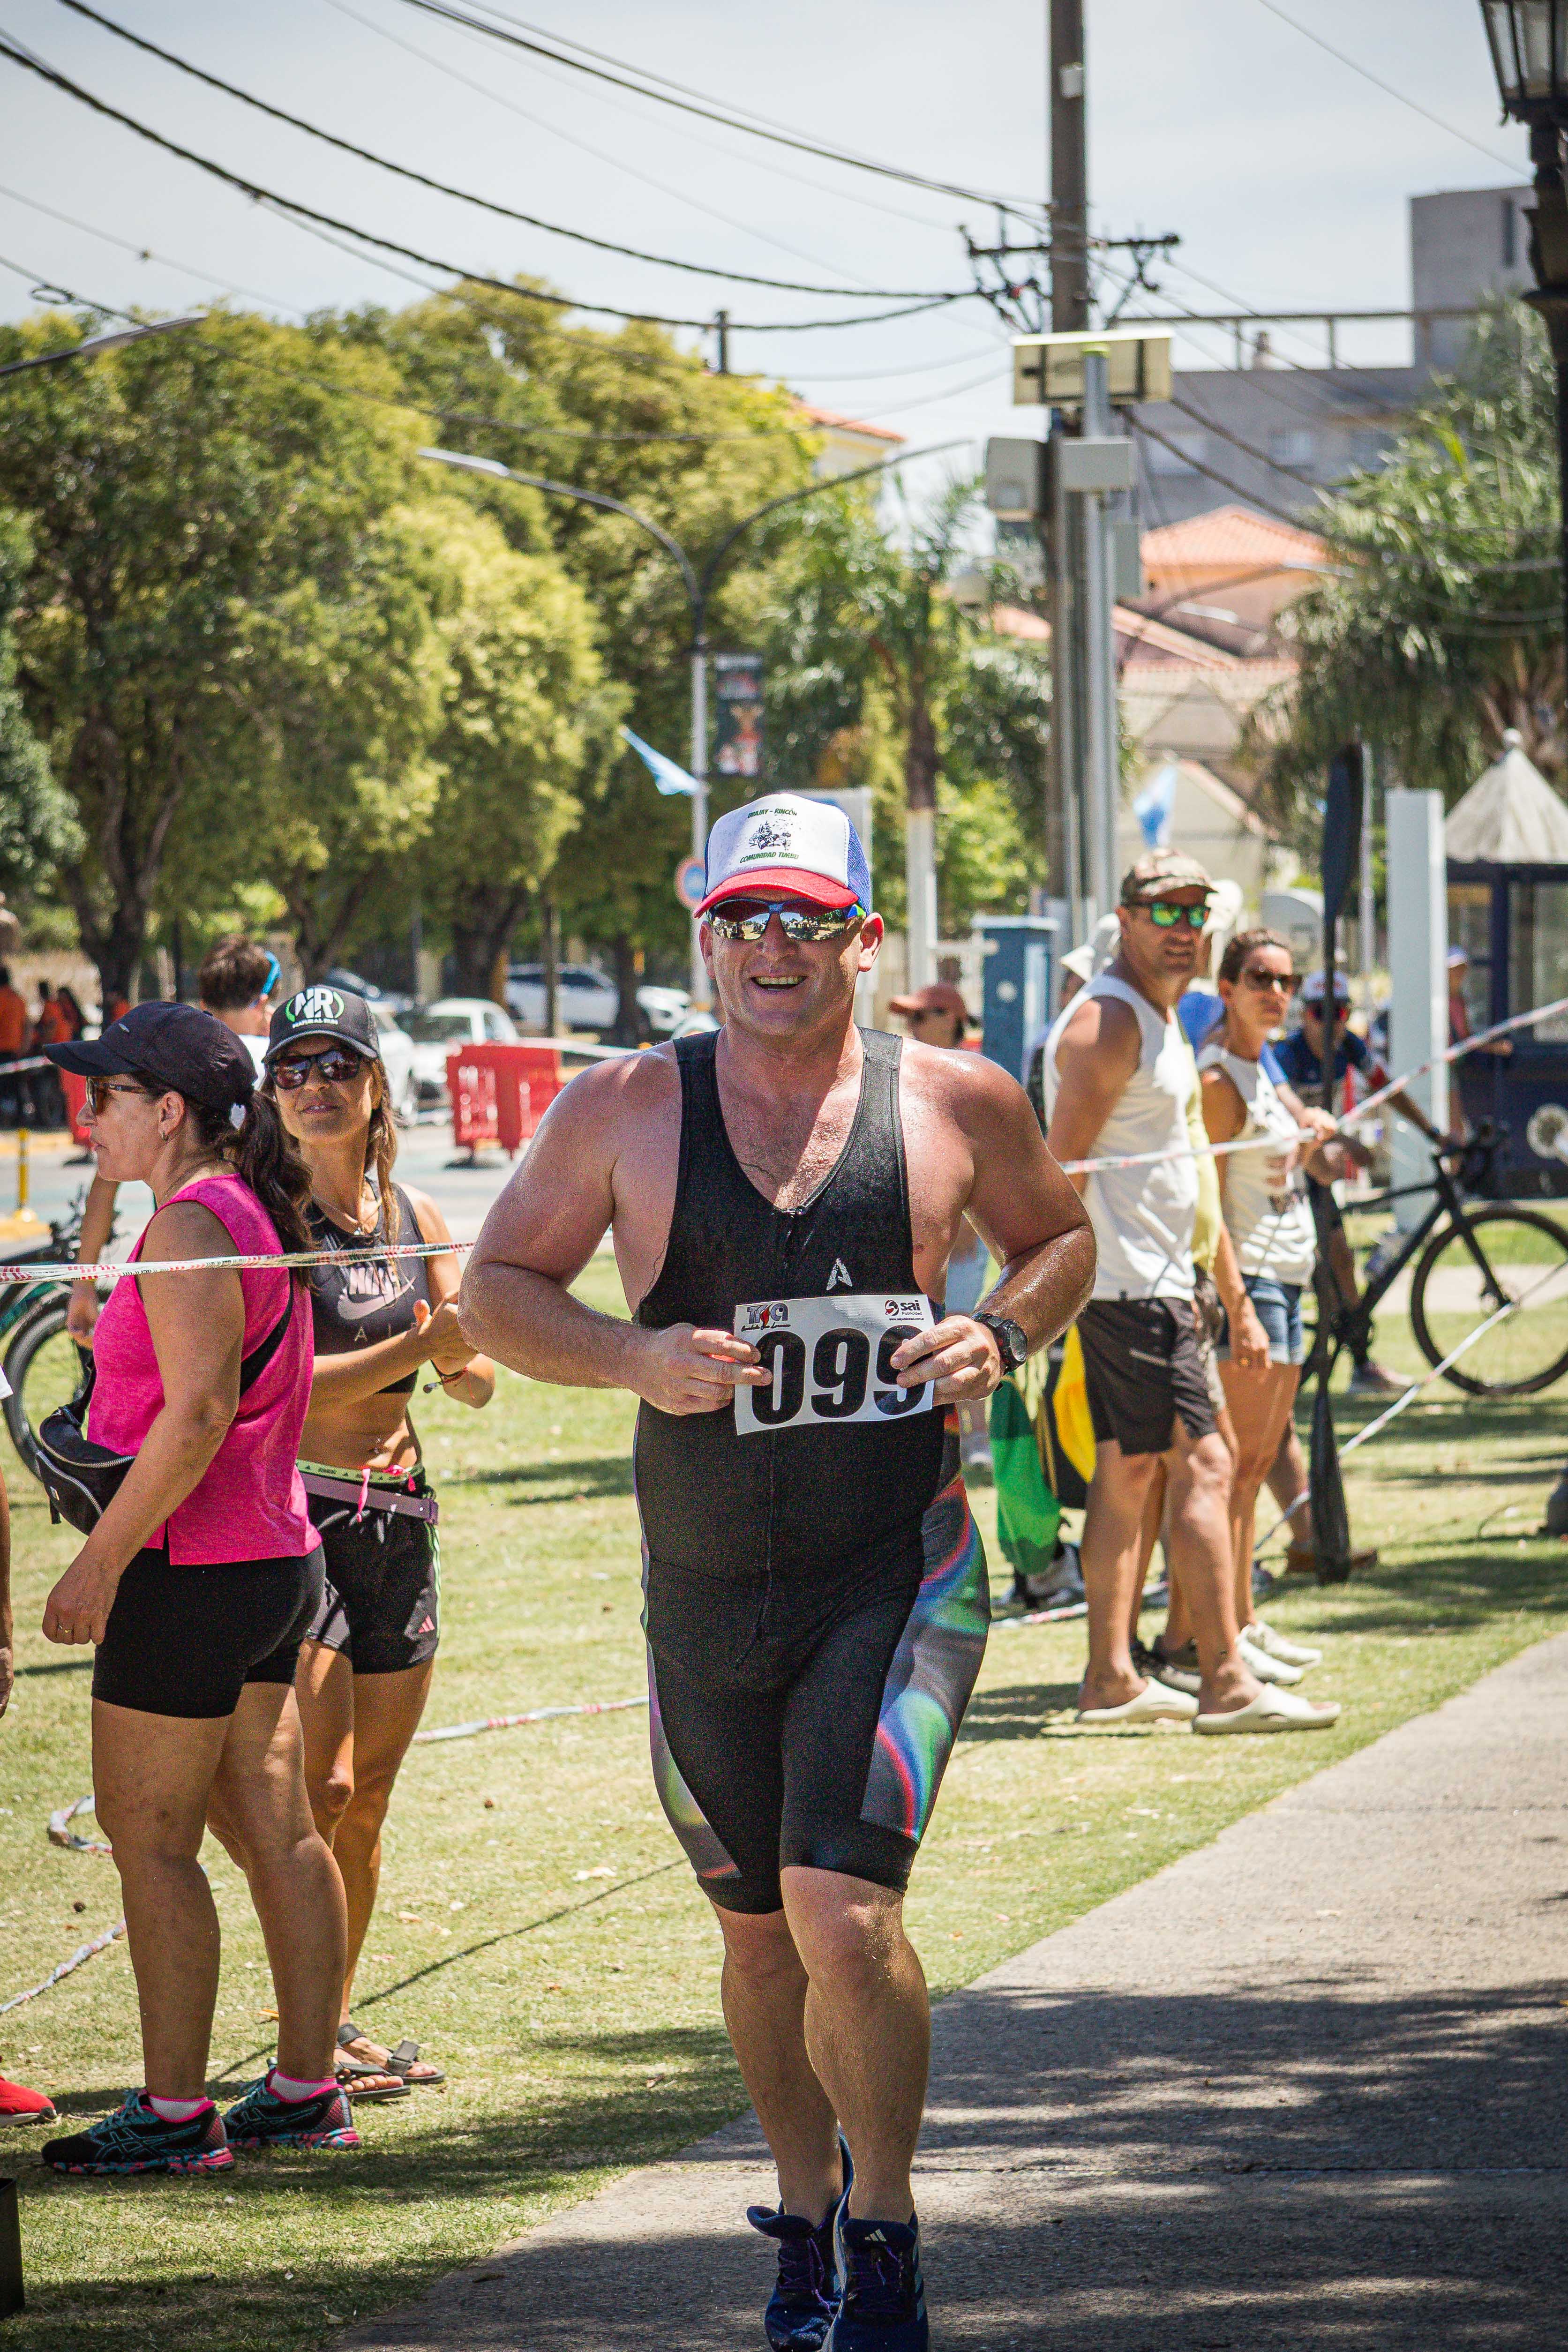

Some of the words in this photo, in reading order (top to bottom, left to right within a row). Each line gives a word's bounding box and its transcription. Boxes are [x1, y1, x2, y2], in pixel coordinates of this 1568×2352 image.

[740, 852, 777, 863] COMUNIDAD
[900, 1300, 921, 1311] sai
[751, 1325, 930, 1425] 099
